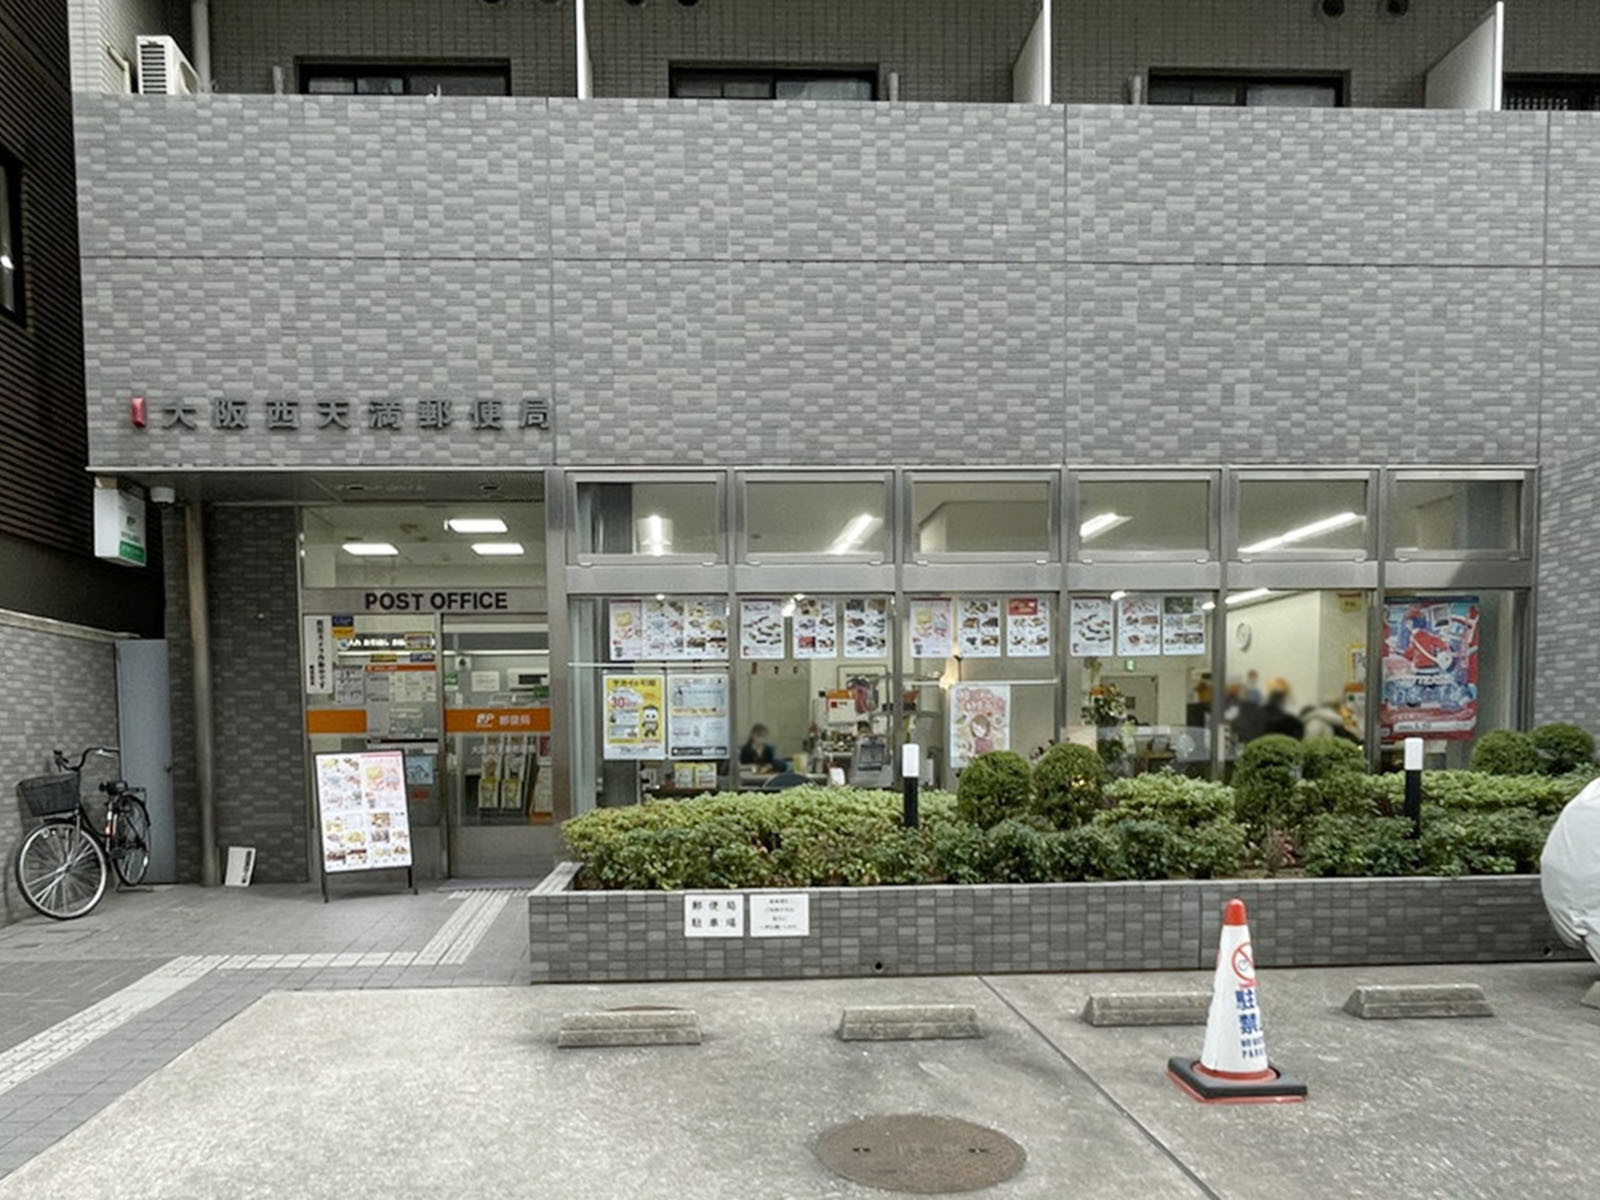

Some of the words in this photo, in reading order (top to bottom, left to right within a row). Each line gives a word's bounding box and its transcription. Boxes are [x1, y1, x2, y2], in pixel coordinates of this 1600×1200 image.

[162, 400, 551, 430] 大阪西天満郵便局
[365, 592, 424, 610] POST
[430, 592, 508, 610] OFFICE
[692, 900, 736, 912] 郵便局
